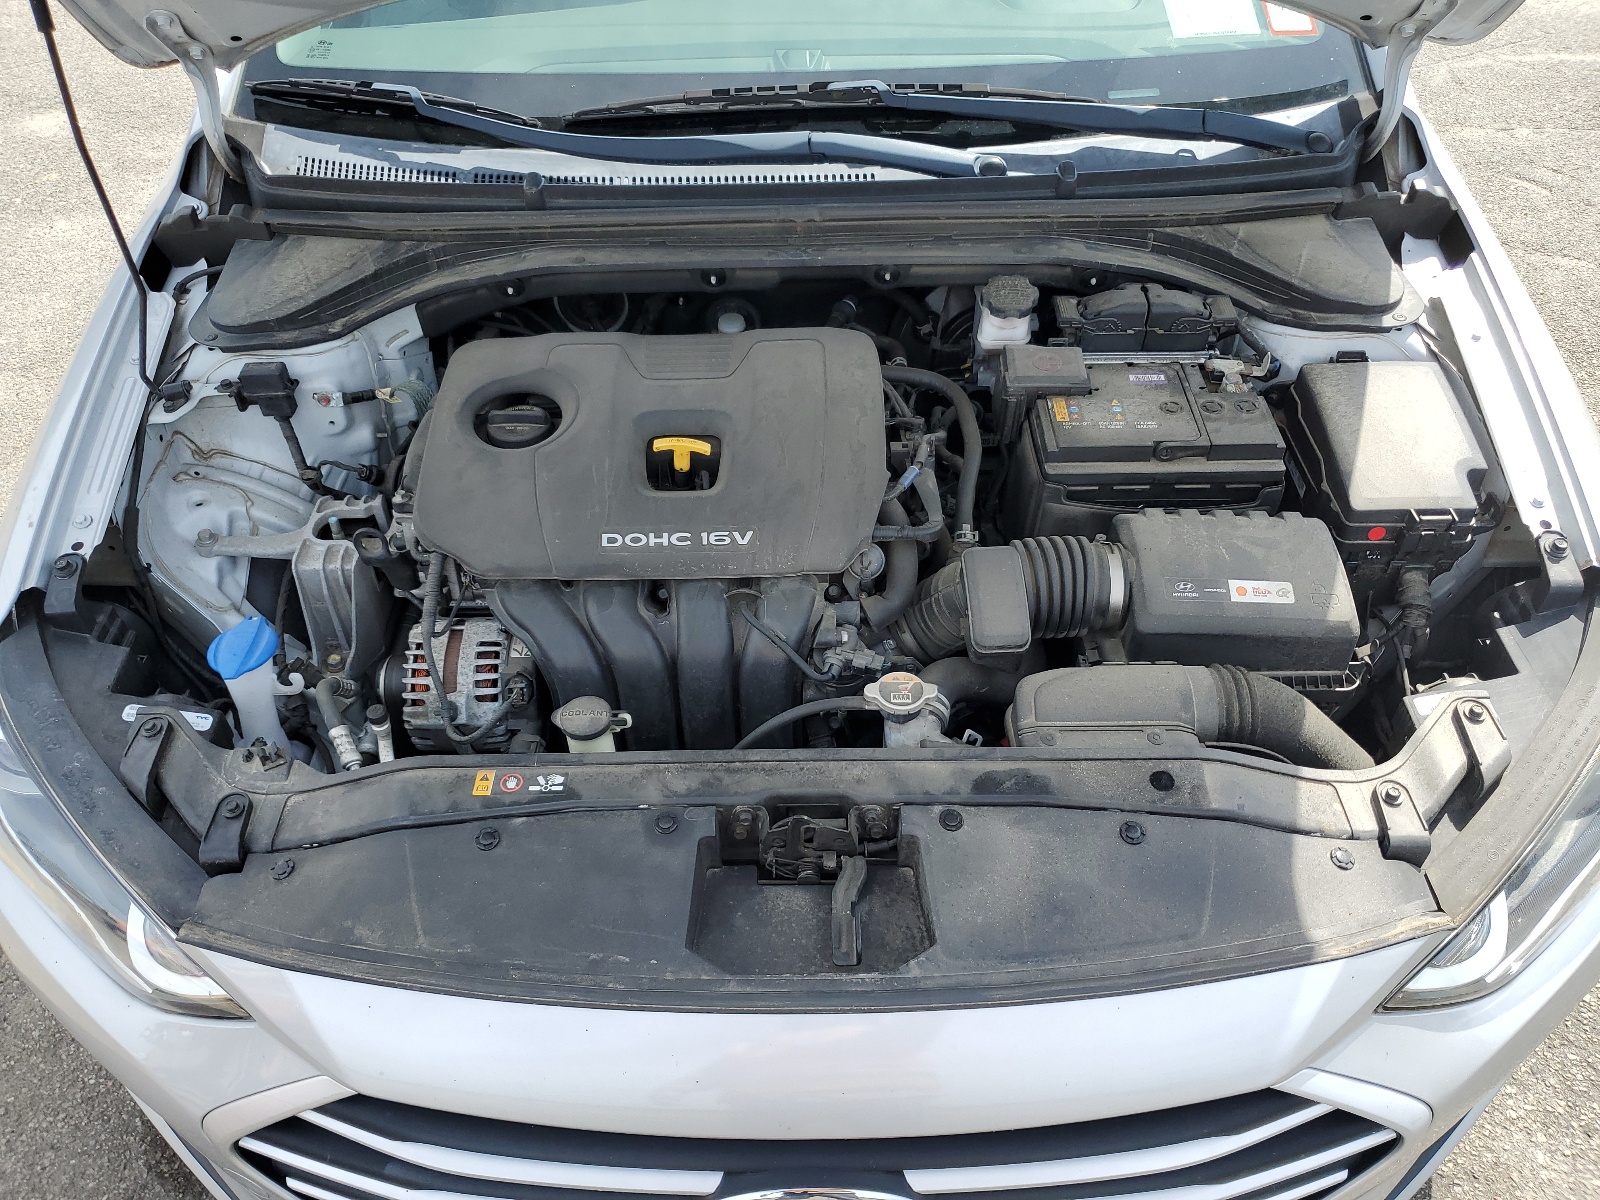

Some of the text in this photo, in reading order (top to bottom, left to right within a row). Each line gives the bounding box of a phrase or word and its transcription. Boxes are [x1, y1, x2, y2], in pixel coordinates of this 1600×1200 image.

[601, 530, 754, 547] DOHC 16V
[560, 709, 610, 718] COOLANT
